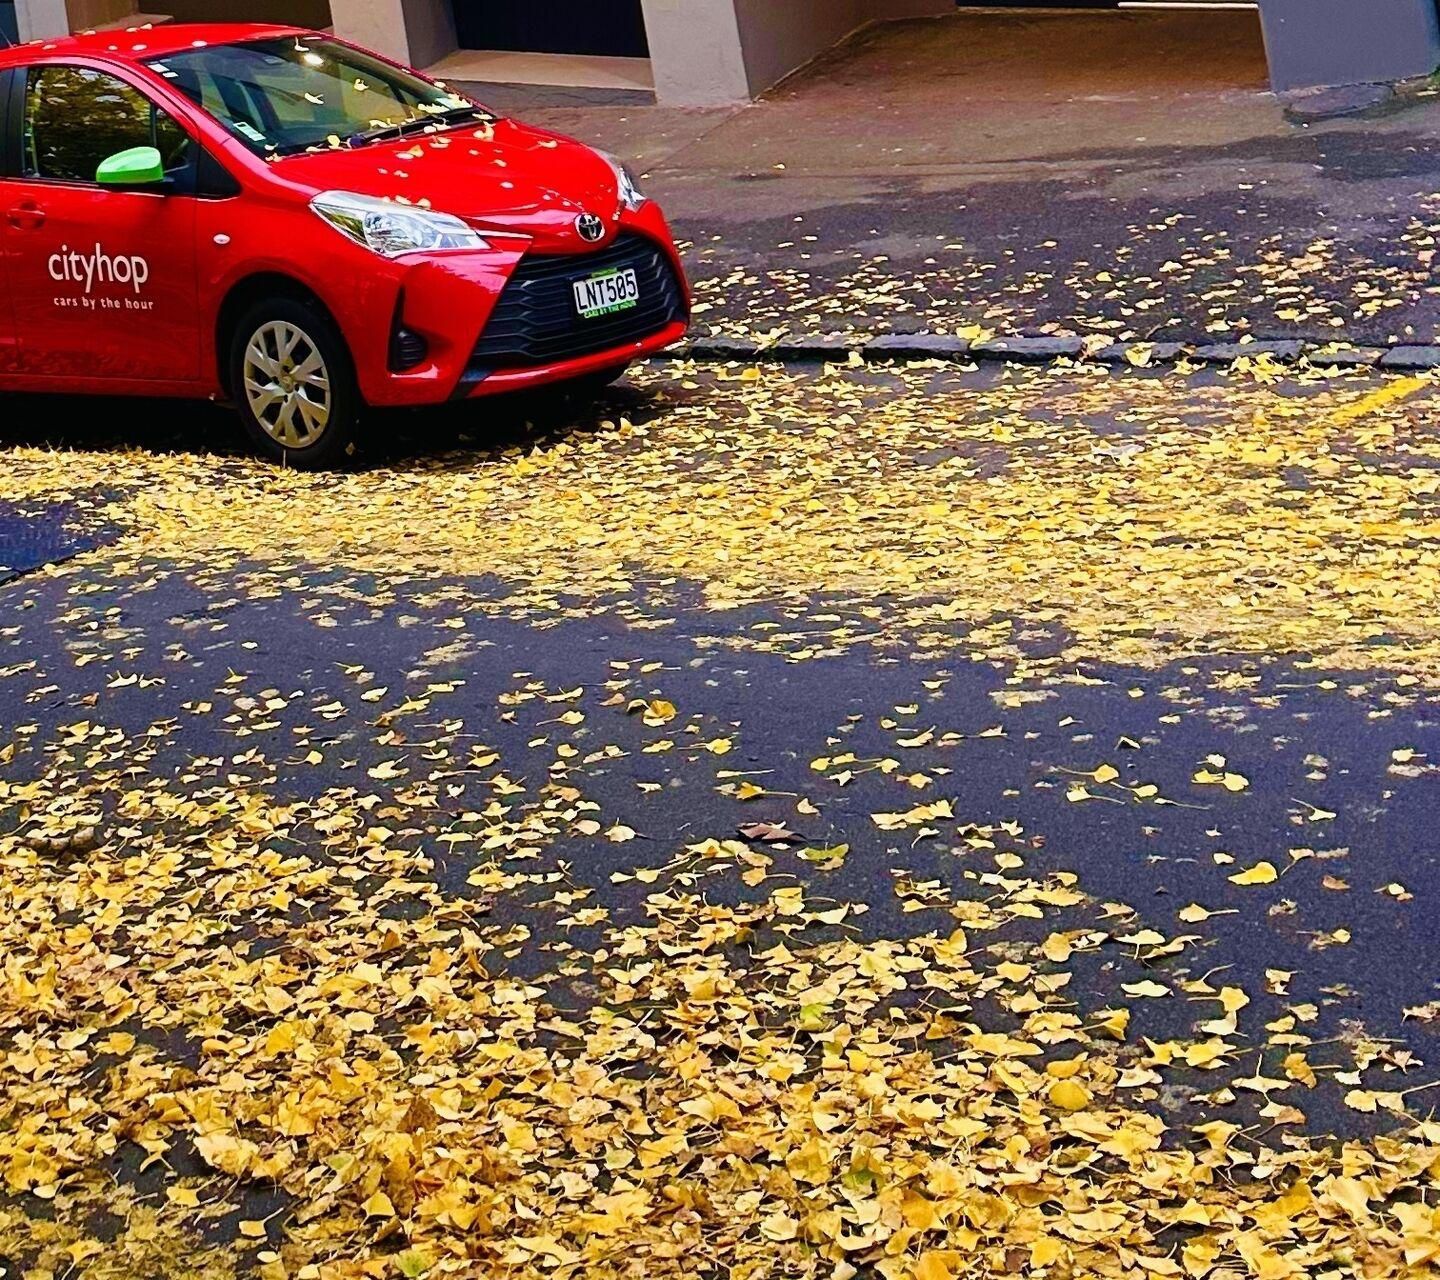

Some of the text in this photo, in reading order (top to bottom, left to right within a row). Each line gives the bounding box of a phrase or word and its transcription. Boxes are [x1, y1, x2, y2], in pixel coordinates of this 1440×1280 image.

[48, 242, 148, 293] cityhop
[53, 296, 154, 310] cars by the hour
[575, 273, 637, 310] LNT505
